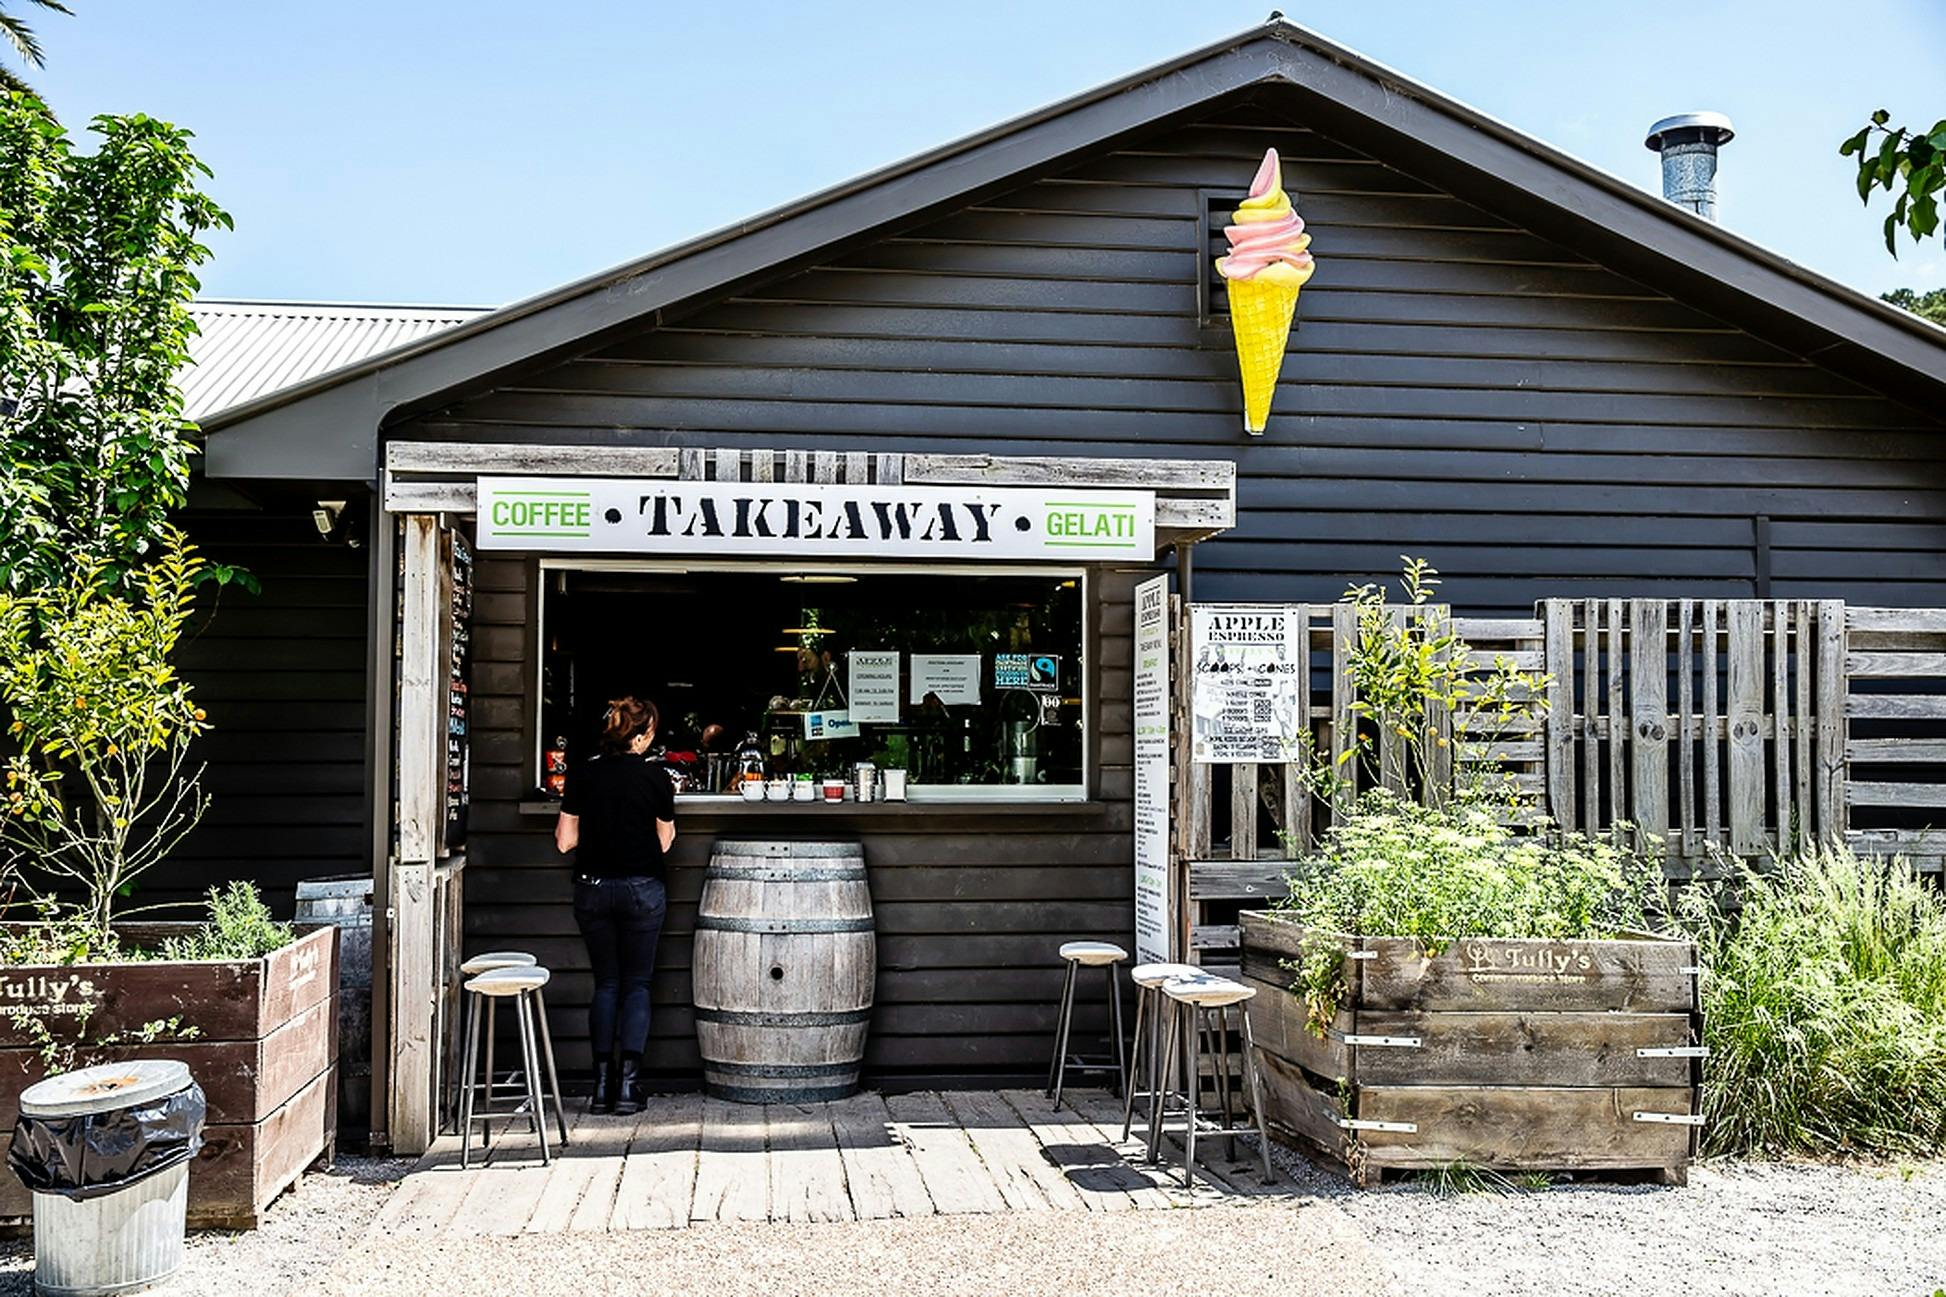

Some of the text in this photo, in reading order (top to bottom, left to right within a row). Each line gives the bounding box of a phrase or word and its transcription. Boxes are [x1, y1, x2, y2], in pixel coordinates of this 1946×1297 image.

[491, 499, 591, 529] COFFEE
[638, 494, 1003, 543] TAKEAWAY
[1046, 510, 1137, 539] GELATI
[1208, 617, 1285, 631] APPLE
[1208, 632, 1285, 641] ESPRESSO
[995, 676, 1028, 685] HERE
[1505, 948, 1591, 973] Tully's
